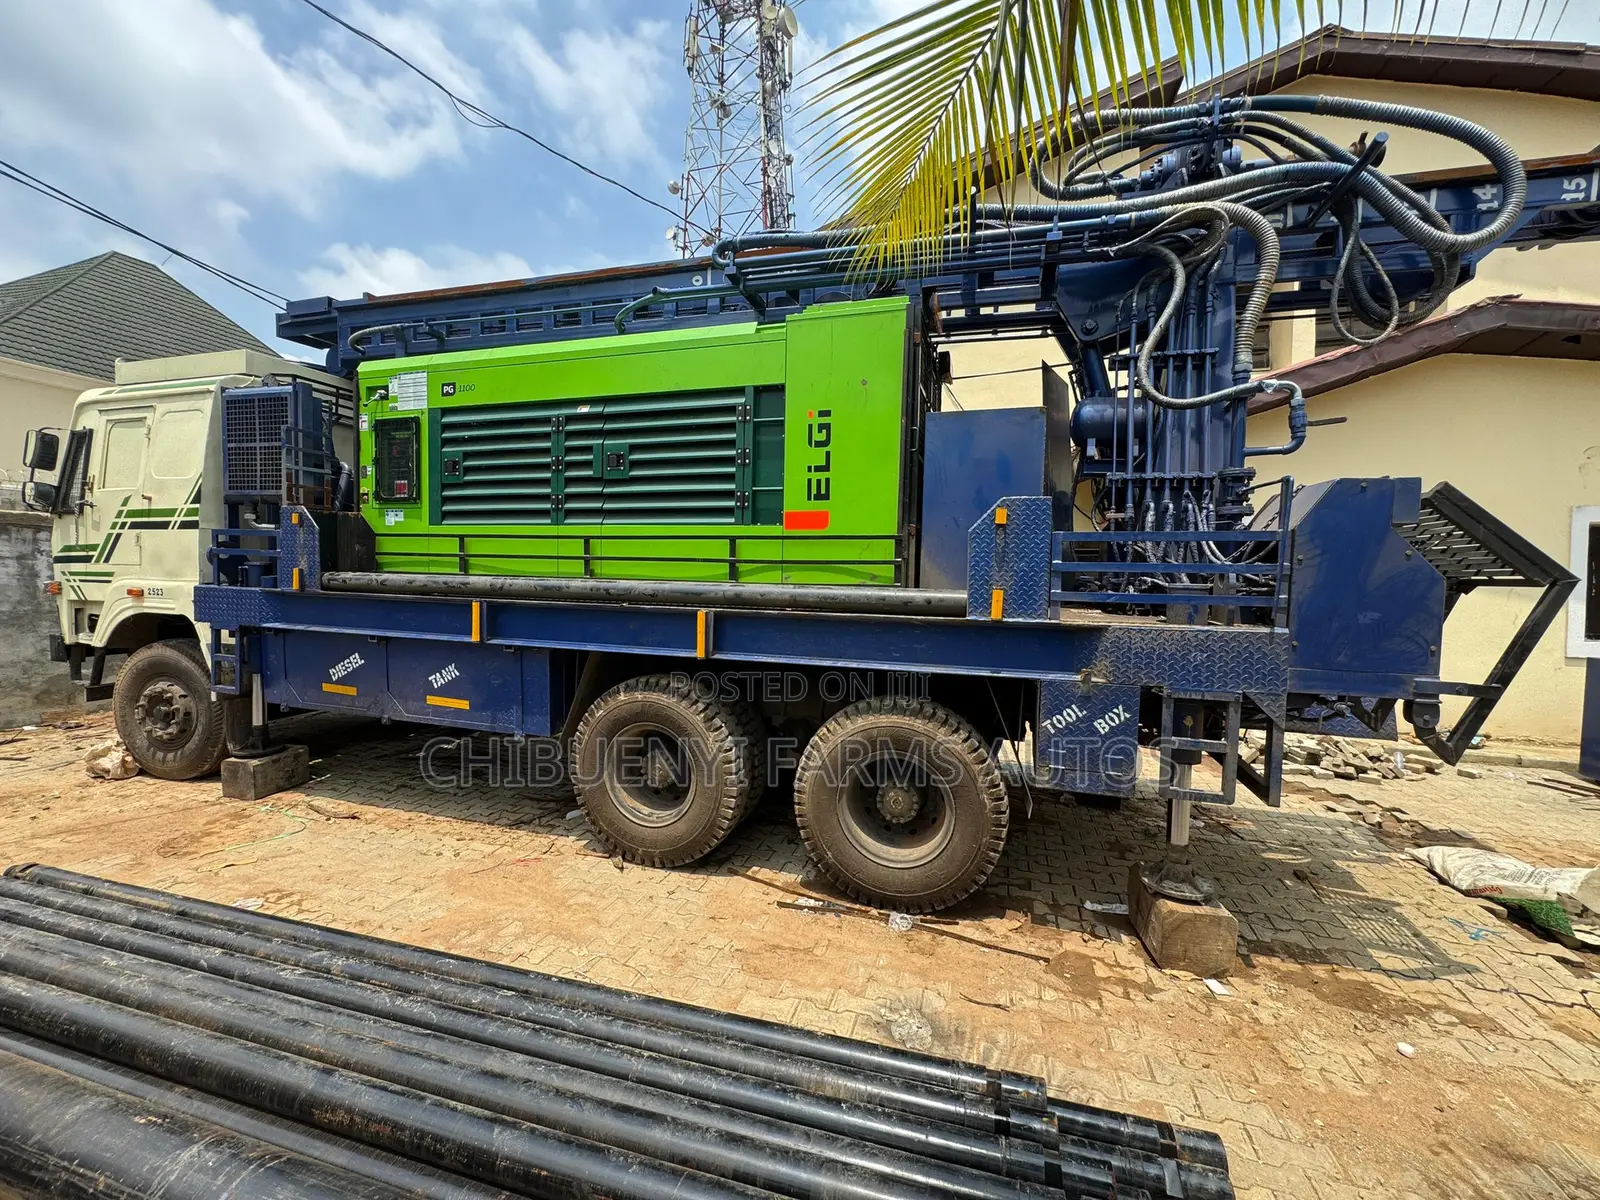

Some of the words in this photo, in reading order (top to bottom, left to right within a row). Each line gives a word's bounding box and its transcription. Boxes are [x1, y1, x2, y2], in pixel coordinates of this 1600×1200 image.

[1472, 184, 1499, 210] 14
[1560, 177, 1587, 201] 15
[443, 385, 454, 394] PG
[458, 383, 476, 393] 1100
[147, 587, 164, 597] 2523
[328, 652, 365, 682] DIESEL
[428, 662, 461, 689] TANK
[1040, 703, 1088, 734] TOOL
[1092, 704, 1132, 735] BOX
